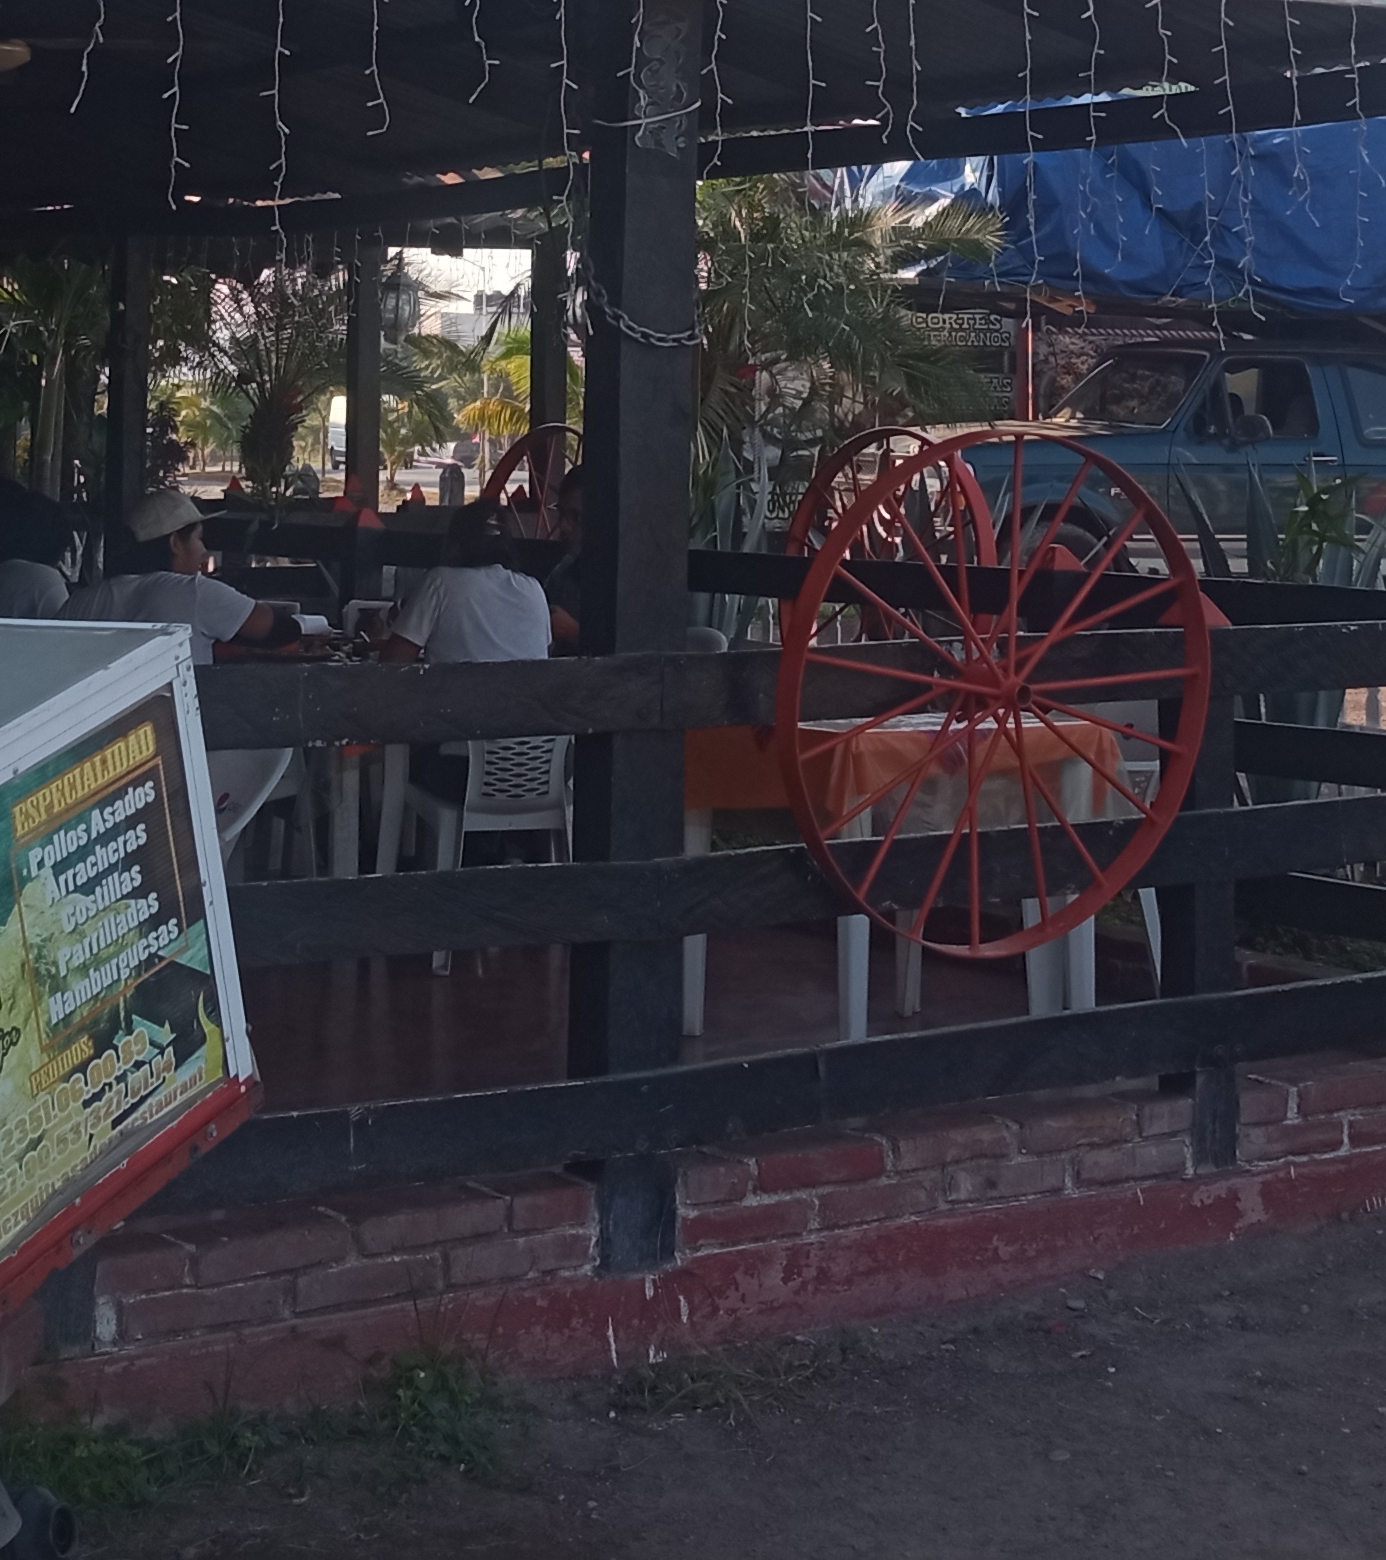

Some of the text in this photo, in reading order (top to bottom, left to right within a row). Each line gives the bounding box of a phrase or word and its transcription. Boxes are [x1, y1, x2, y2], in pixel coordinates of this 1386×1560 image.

[913, 313, 1001, 329] CORTES
[921, 331, 1011, 346] ERICANOS
[13, 724, 155, 837] ESPECIALIDAD
[28, 781, 156, 878] Pollos Asados
[43, 823, 147, 907] Arracheras
[58, 892, 159, 978] Parrilladas
[62, 864, 142, 933] Costillas
[49, 918, 179, 1026] Hamburguesas
[30, 1036, 95, 1097] PEDIDOS:
